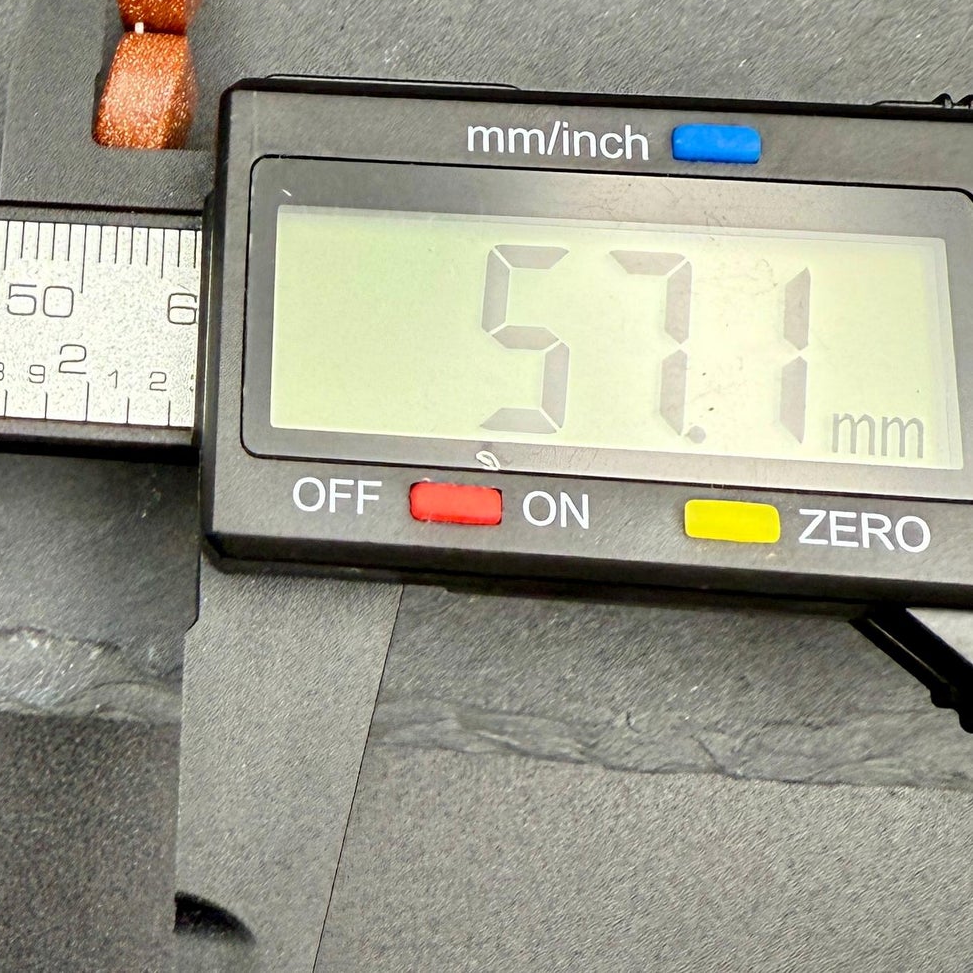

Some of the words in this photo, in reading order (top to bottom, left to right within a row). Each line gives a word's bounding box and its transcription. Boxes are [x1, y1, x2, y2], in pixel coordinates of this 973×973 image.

[466, 119, 650, 162] mm/inch
[6, 283, 75, 318] 50
[28, 364, 47, 384] 9
[57, 343, 87, 375] 2
[107, 369, 119, 389] 1
[148, 371, 168, 392] 2
[480, 243, 812, 446] 57.1
[830, 411, 925, 460] mm
[292, 475, 383, 516] OFF
[521, 489, 590, 529] ON
[797, 507, 932, 554] ZERO
